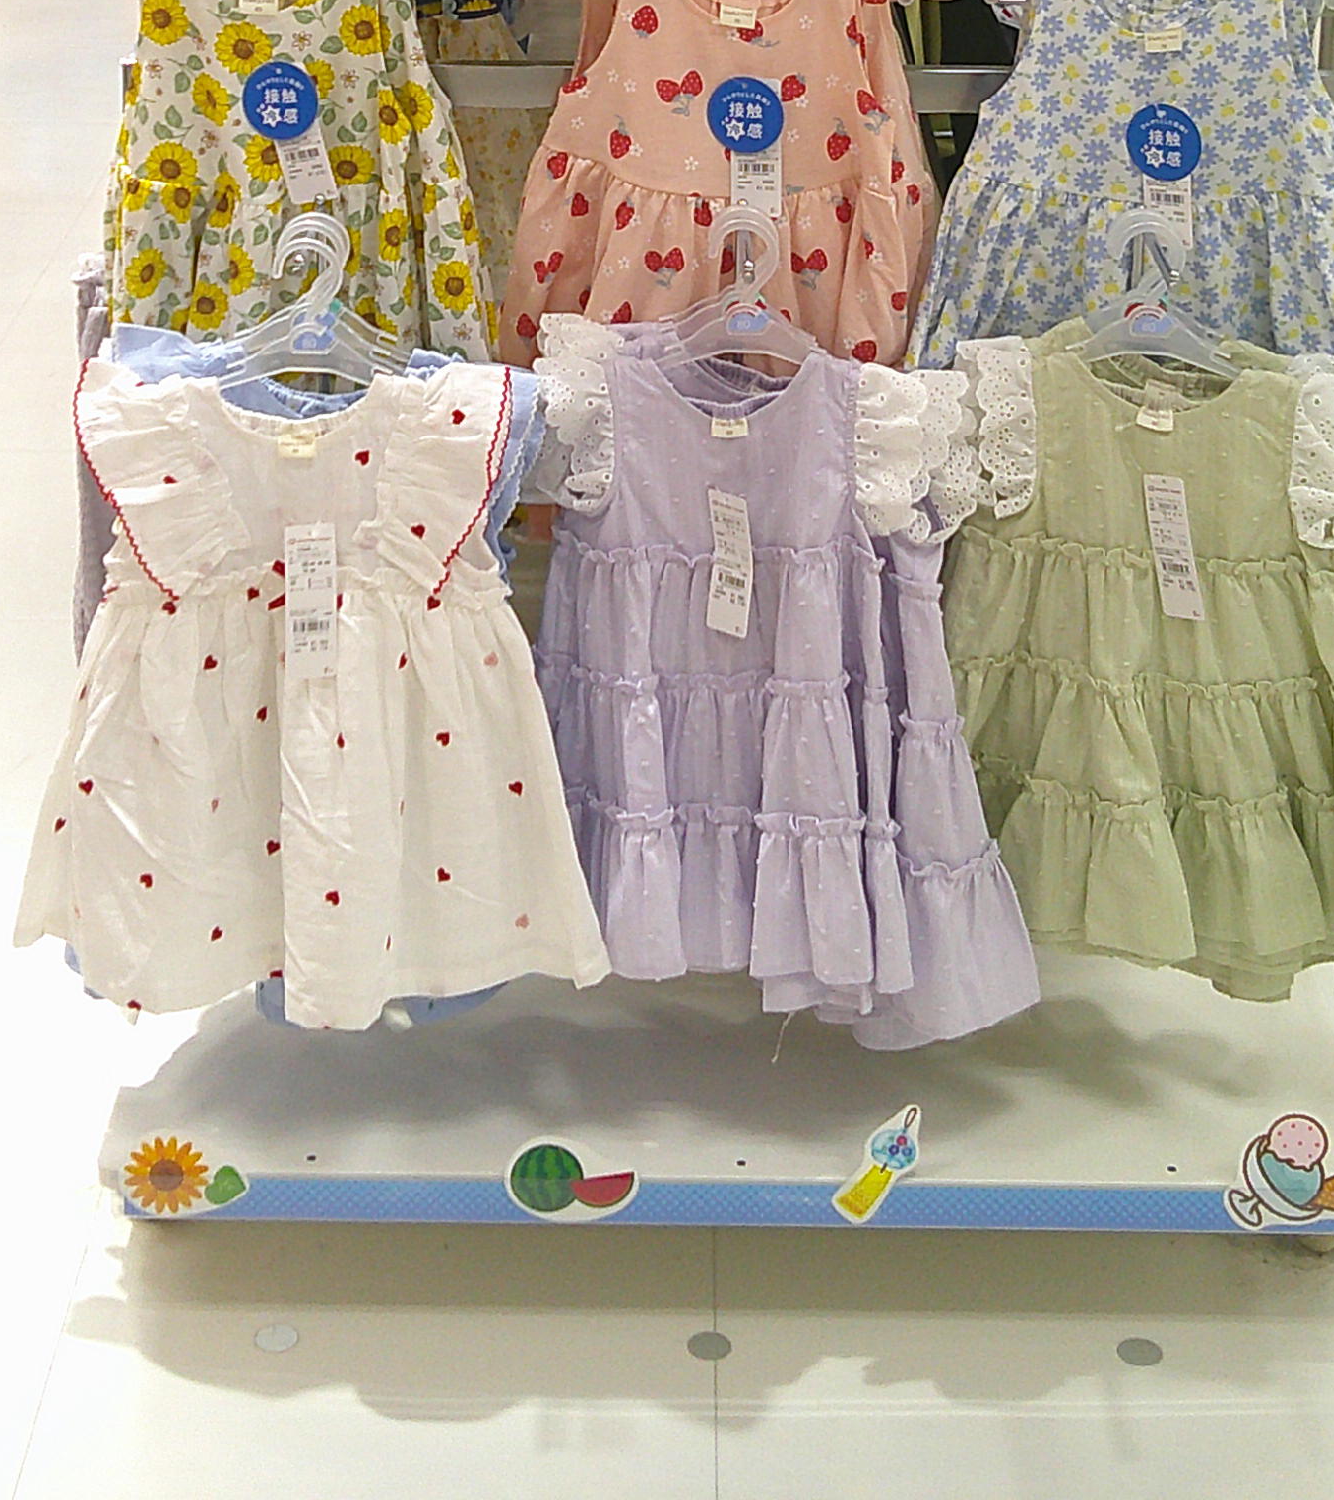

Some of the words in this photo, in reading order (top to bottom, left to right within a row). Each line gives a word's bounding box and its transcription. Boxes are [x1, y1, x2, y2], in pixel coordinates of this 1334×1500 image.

[264, 88, 297, 104] 接触
[729, 101, 764, 119] 接触
[1148, 130, 1181, 148] 接触
